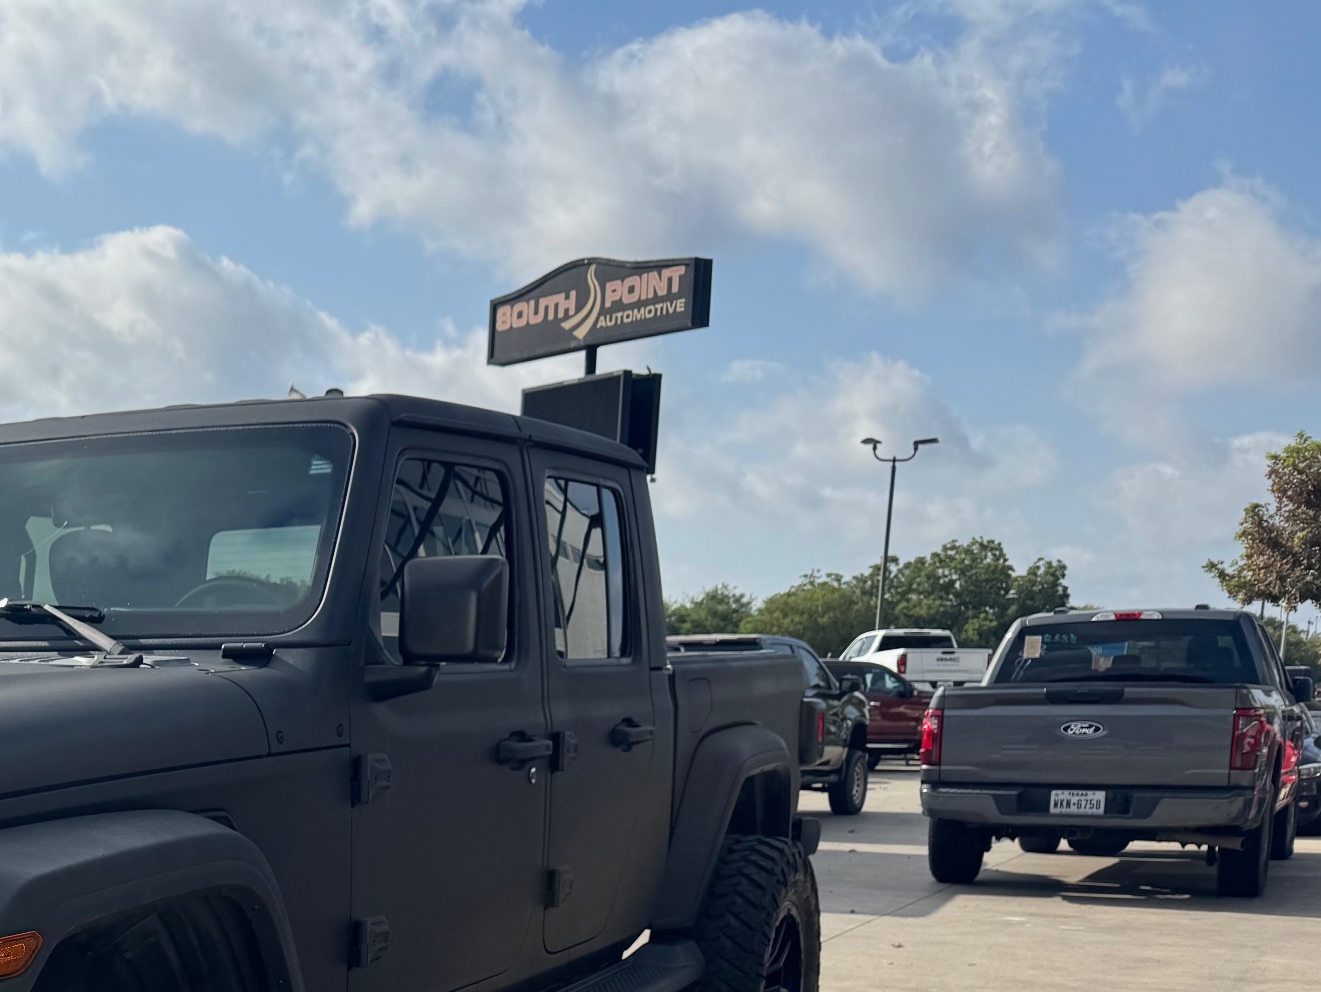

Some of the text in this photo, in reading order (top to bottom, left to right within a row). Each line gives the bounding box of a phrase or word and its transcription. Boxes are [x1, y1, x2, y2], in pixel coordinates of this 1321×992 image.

[495, 265, 686, 332] SOUTH POINT
[597, 298, 685, 329] AUTOMOTIVE
[1066, 722, 1097, 735] Ford
